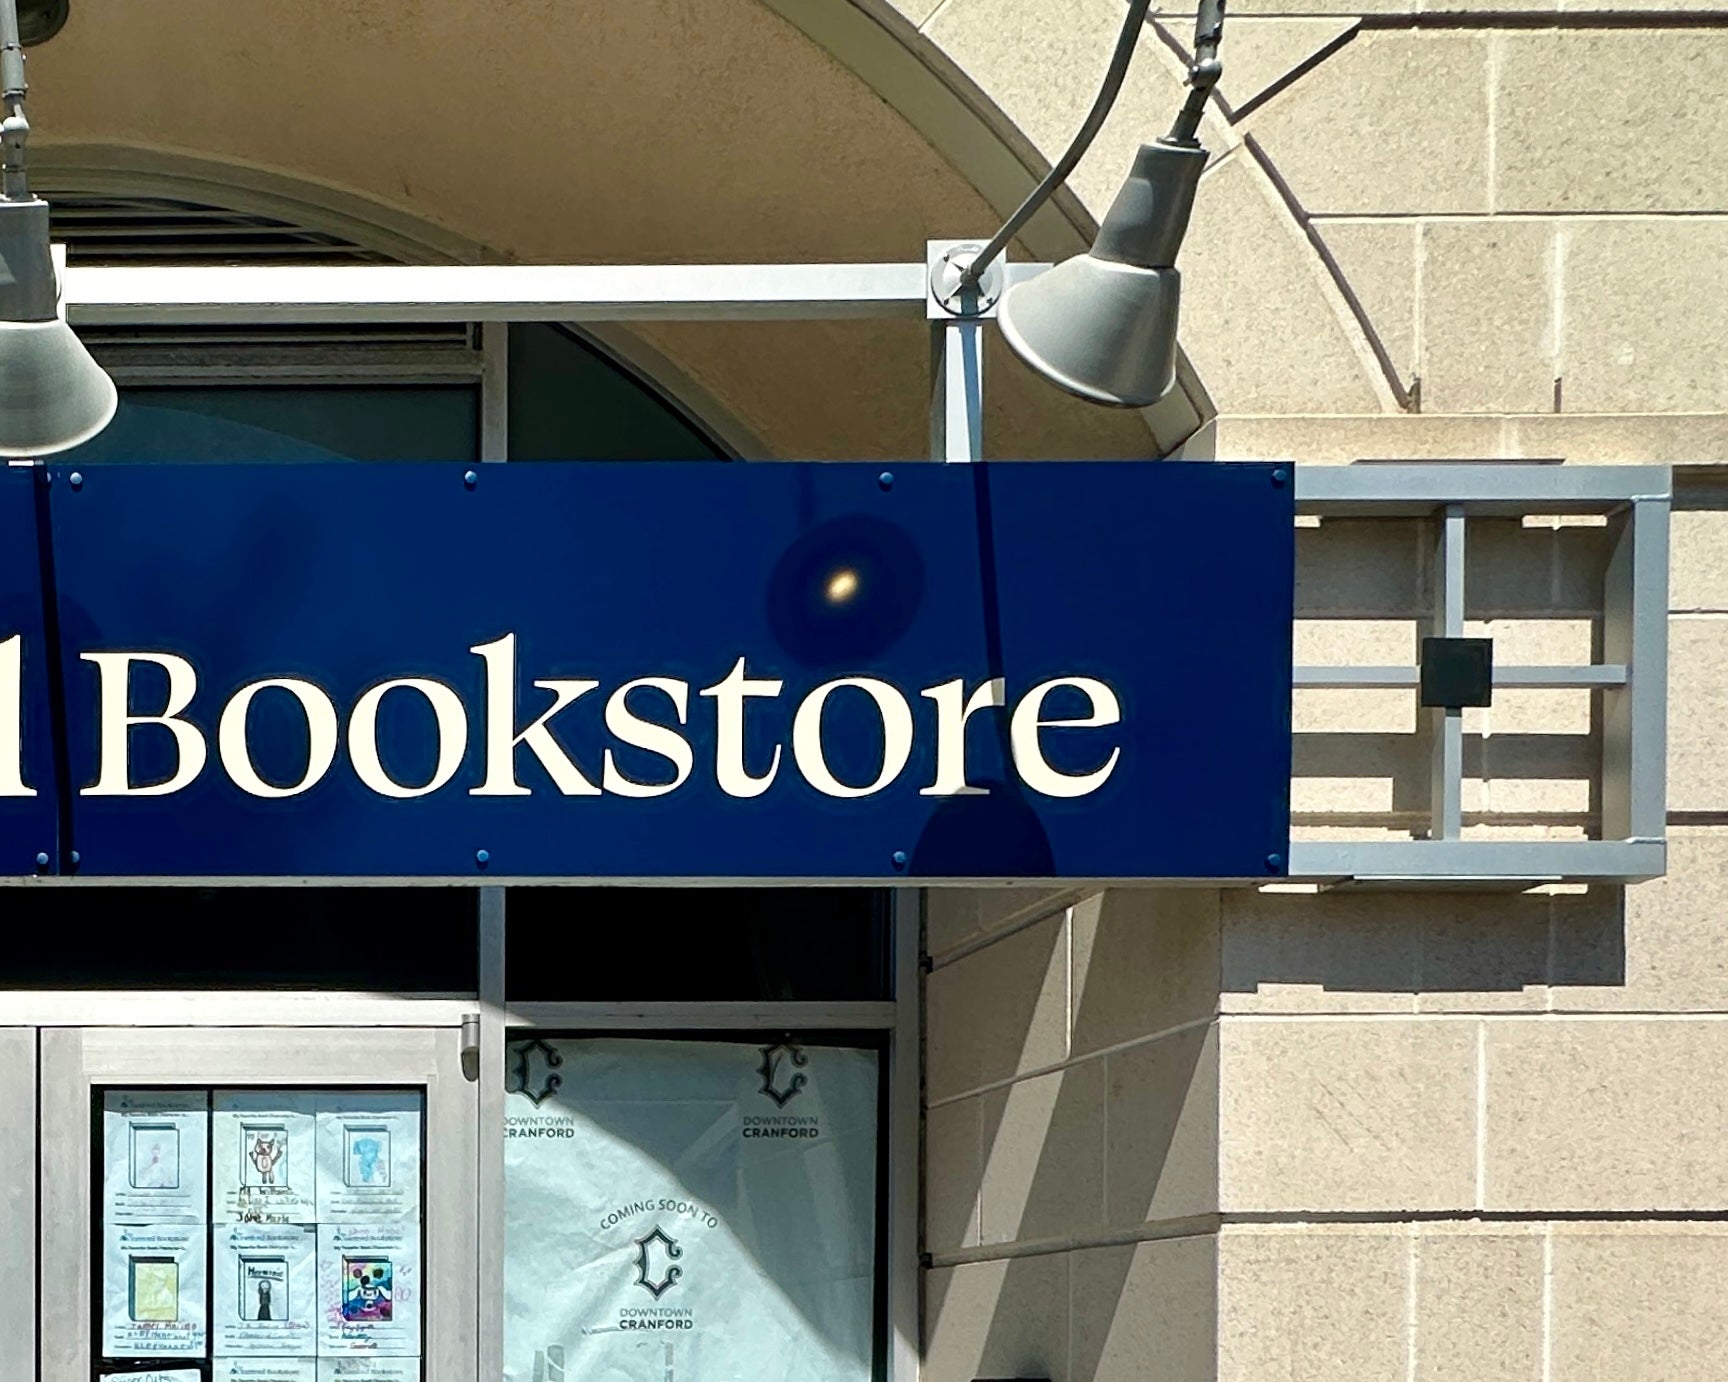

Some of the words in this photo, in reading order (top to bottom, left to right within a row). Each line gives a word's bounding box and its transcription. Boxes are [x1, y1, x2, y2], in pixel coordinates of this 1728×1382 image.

[79, 632, 1121, 799] Bookstore
[743, 1116, 819, 1126] DOWNTOWN
[742, 1128, 819, 1138] CRANFORD
[600, 1199, 655, 1230] COMING
[658, 1199, 700, 1220] SOON
[700, 1211, 718, 1229] TO
[620, 1308, 693, 1317] DOWNTOWN
[619, 1319, 693, 1330] CRANFORD
